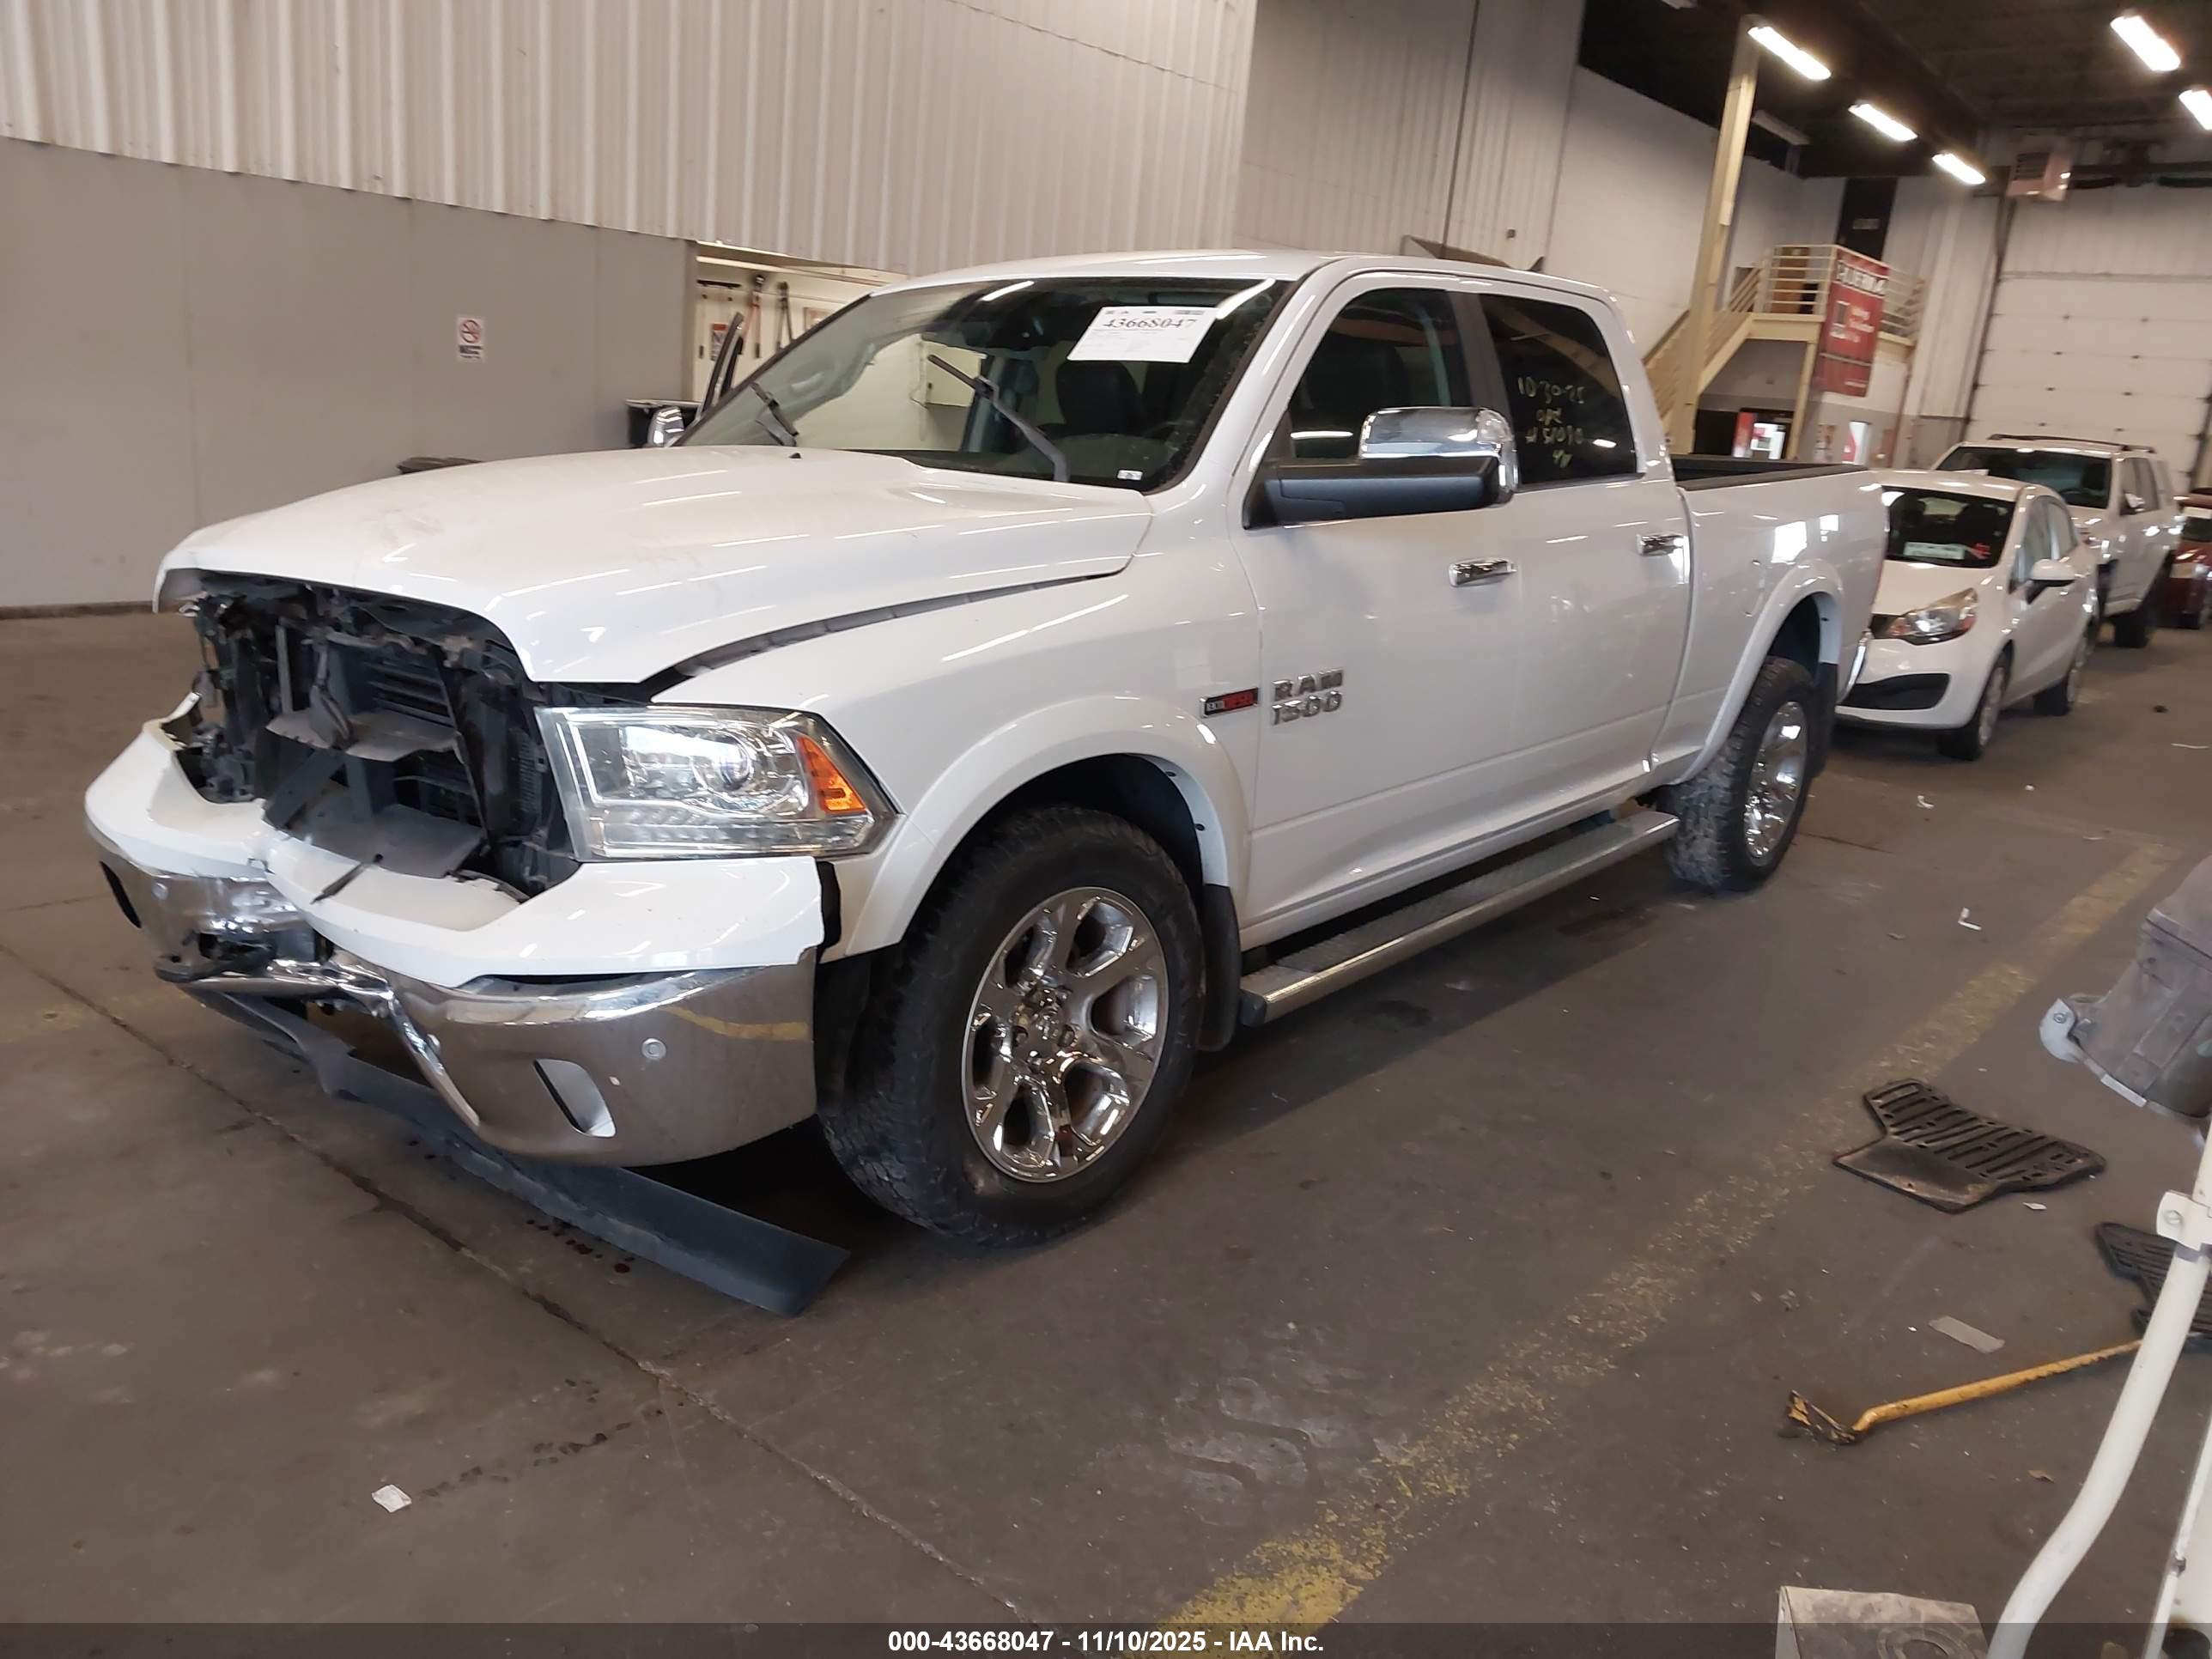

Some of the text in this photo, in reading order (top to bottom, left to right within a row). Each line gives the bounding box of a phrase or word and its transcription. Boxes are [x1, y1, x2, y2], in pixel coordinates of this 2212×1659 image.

[1103, 317, 1199, 329] 43668047
[1272, 668, 1343, 702] RAM
[1272, 690, 1342, 726] 1500
